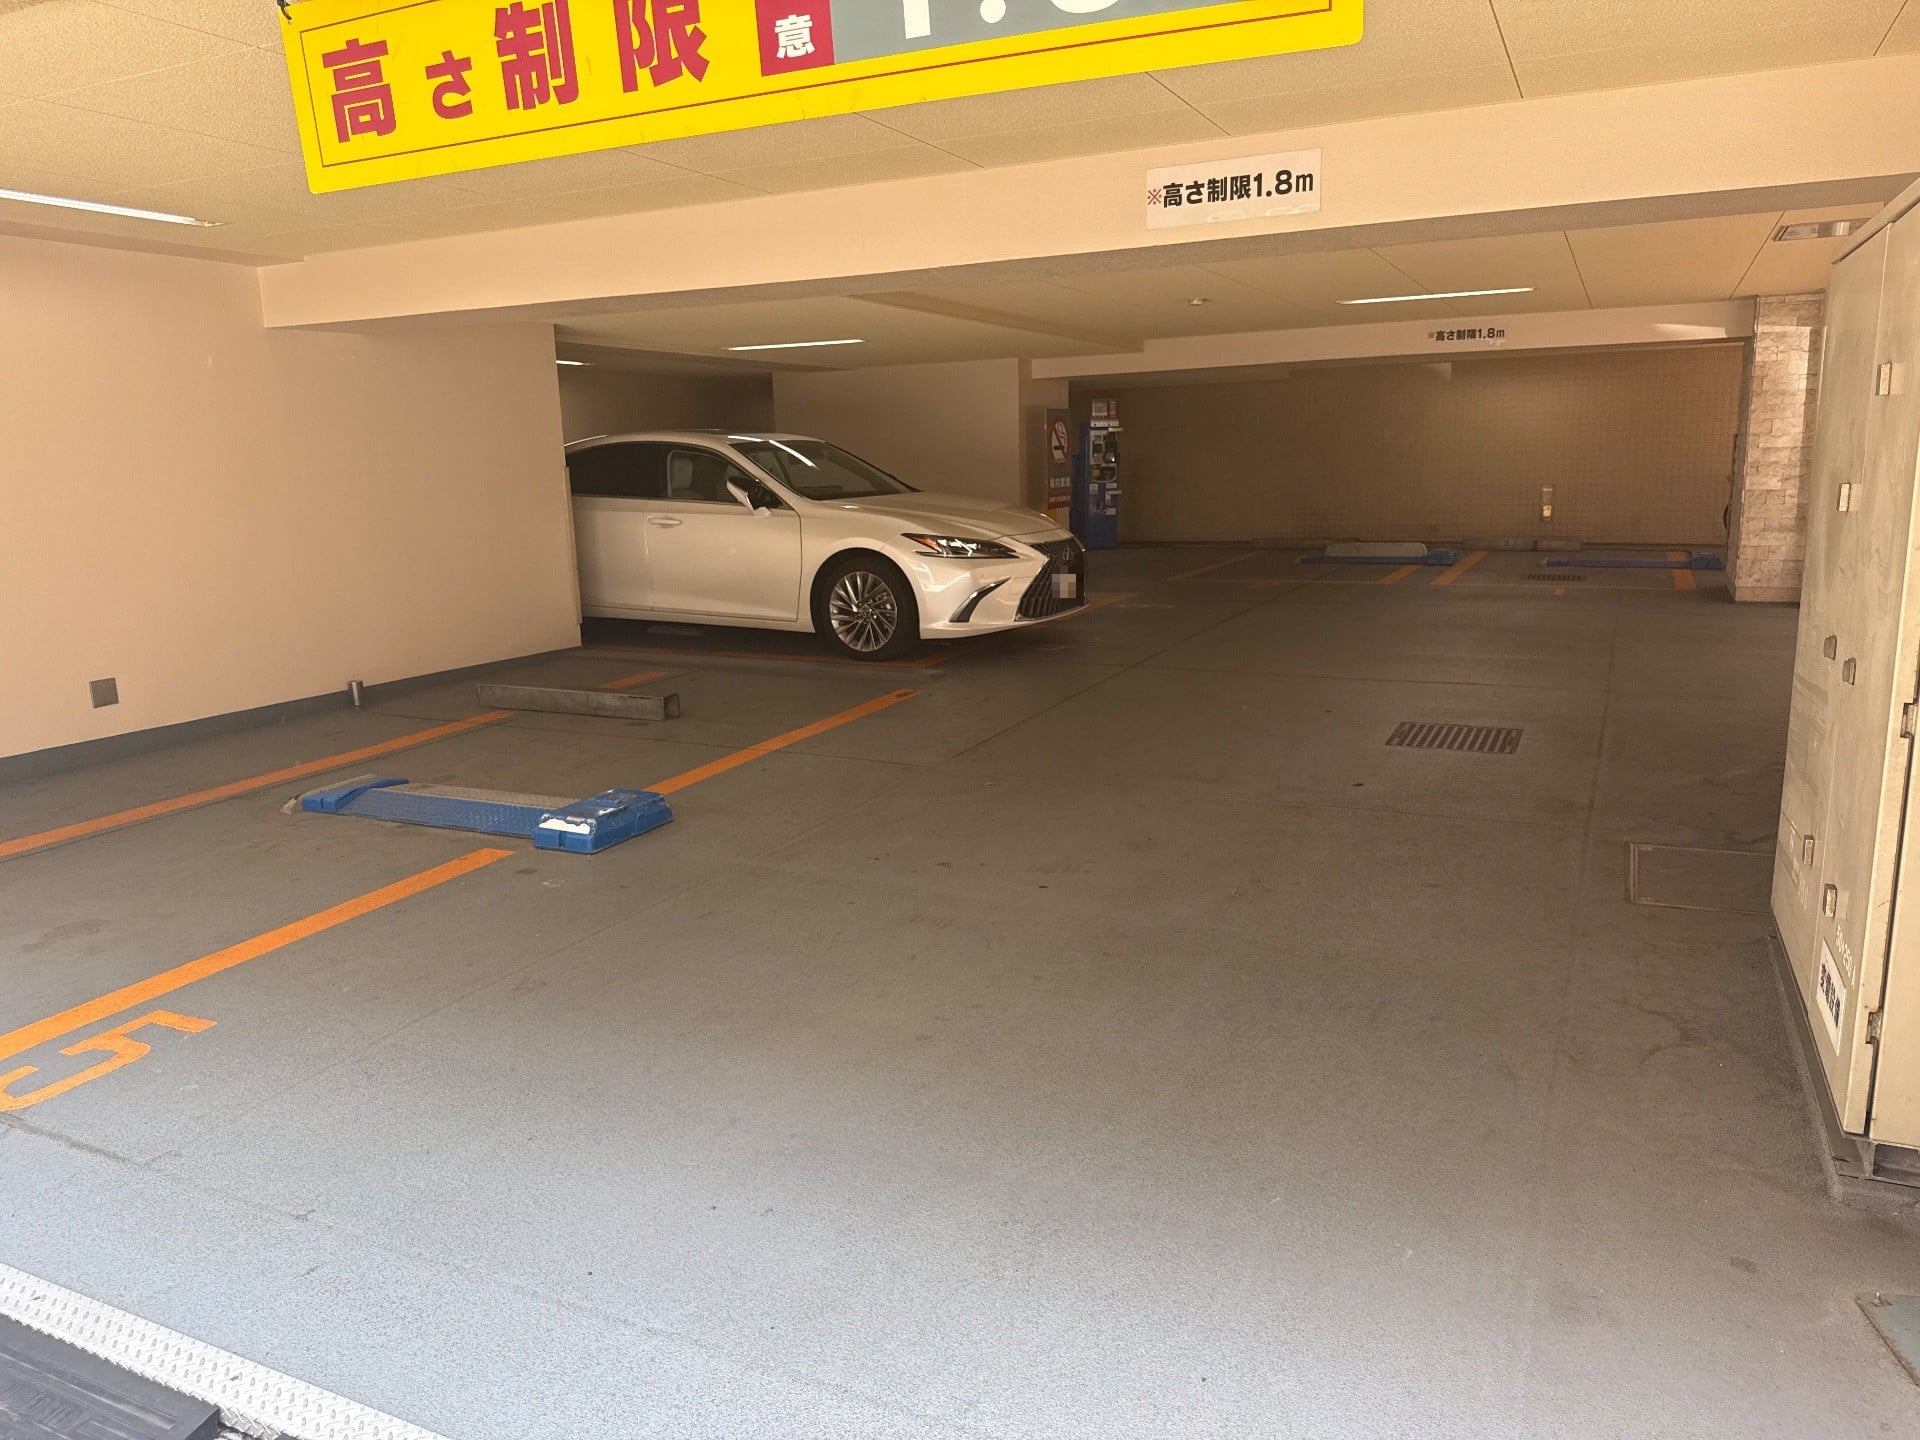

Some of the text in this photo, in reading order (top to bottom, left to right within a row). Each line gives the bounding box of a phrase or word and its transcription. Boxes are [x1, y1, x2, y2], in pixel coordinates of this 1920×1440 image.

[322, 0, 711, 143] 高さ制限
[774, 15, 816, 59] 意
[0, 1009, 218, 1112] 5
